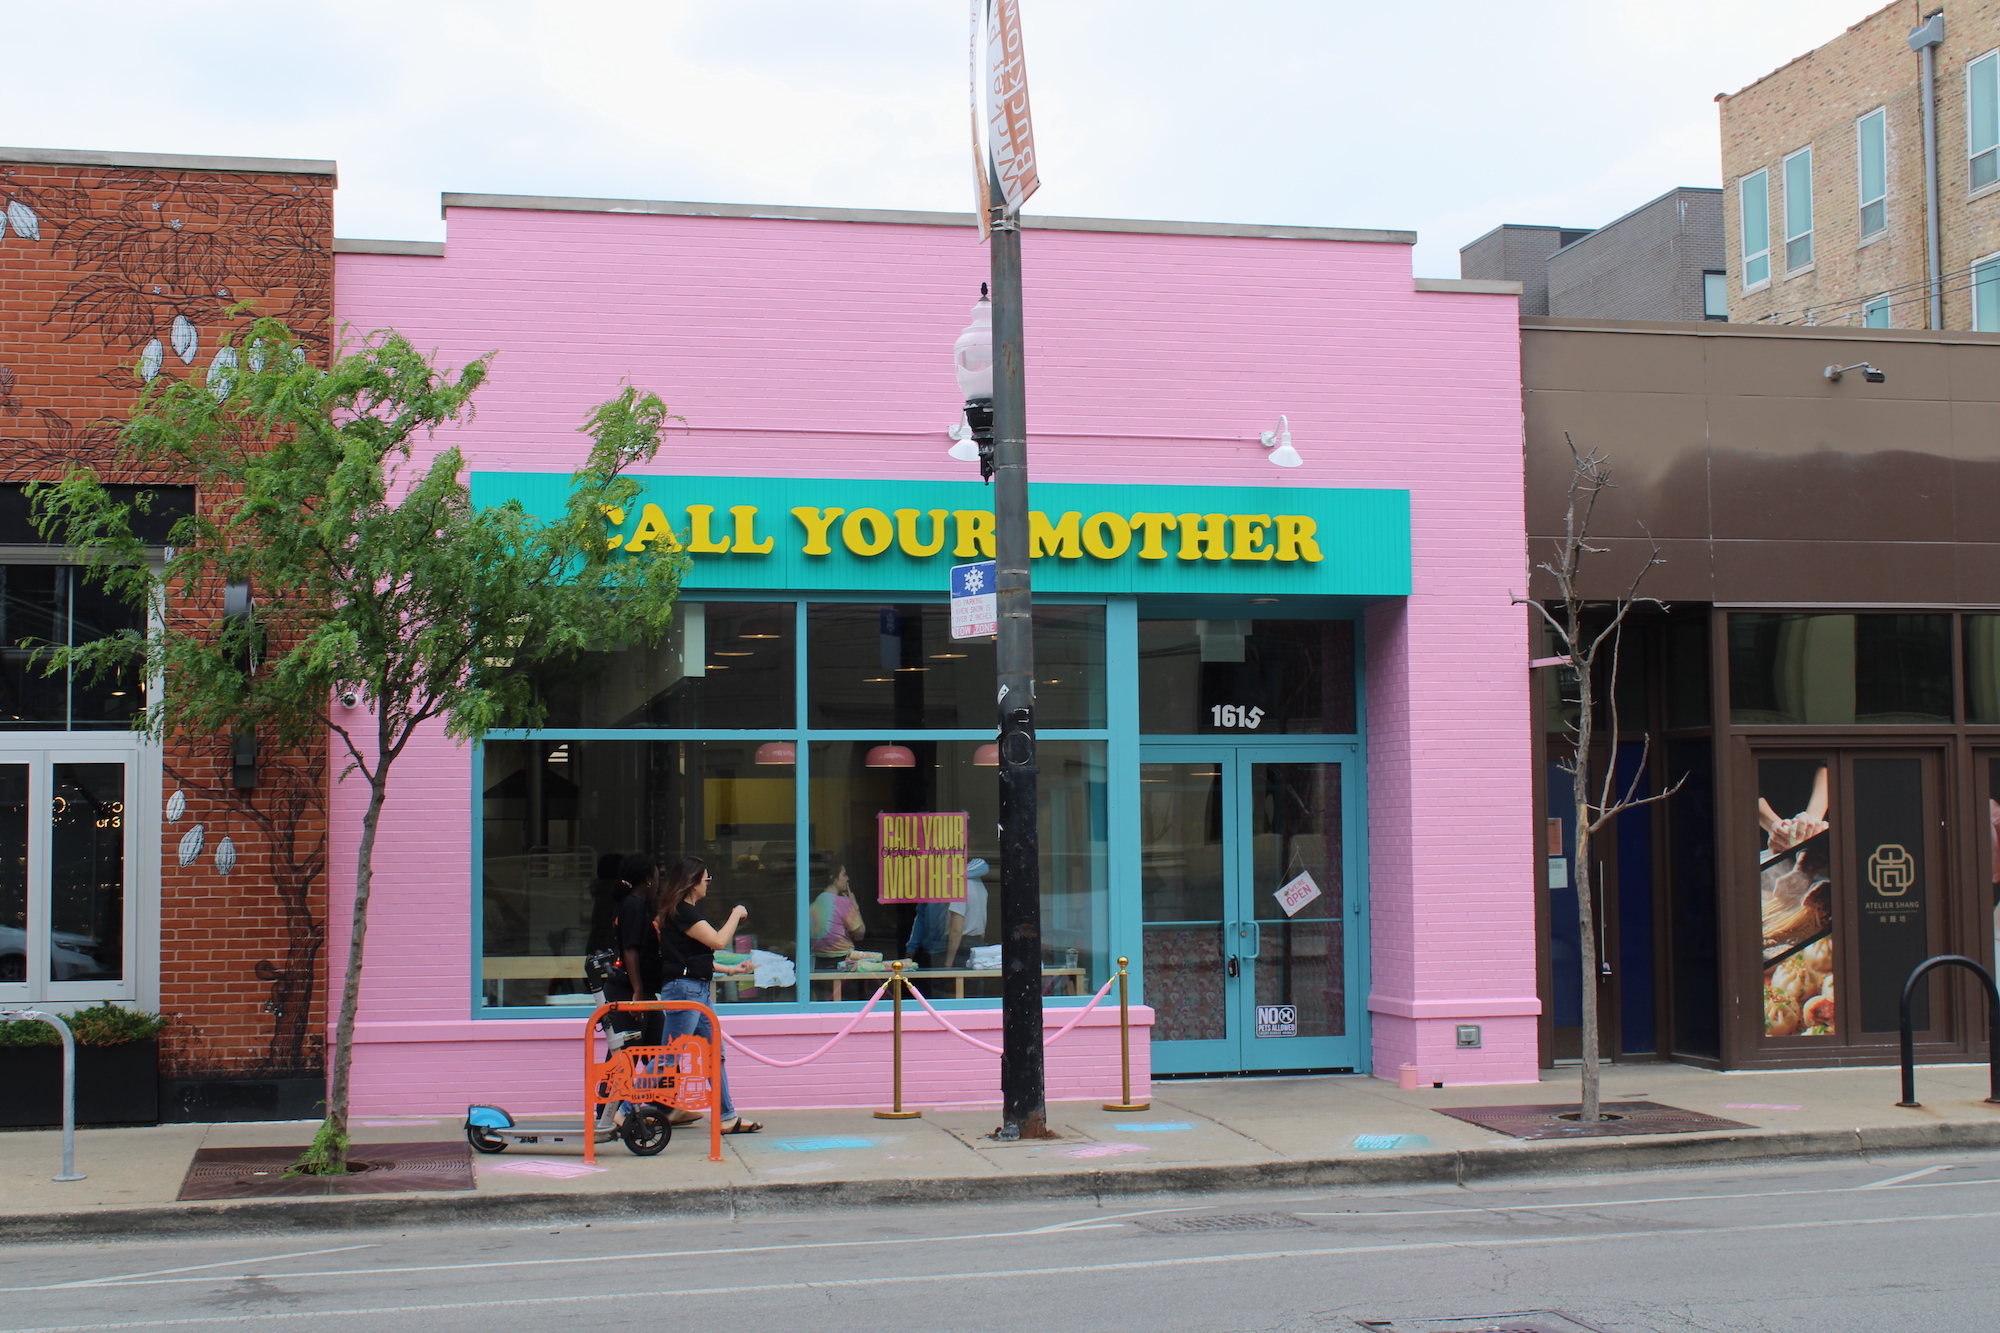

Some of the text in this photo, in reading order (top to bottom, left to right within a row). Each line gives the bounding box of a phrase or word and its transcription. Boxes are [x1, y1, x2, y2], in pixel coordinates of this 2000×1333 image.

[990, 60, 1020, 196] Wicker
[790, 506, 997, 558] YOUR
[1029, 510, 1325, 562] MOTHER
[963, 597, 983, 606] PARKING
[955, 607, 969, 615] WHEN
[970, 605, 984, 613] SNOW
[955, 615, 968, 623] OVER
[975, 612, 993, 620] INCHES
[955, 623, 995, 636] TOW ZONE
[1211, 704, 1266, 730] 1615
[883, 815, 965, 851] CALL YOUR
[881, 846, 923, 859] OPENING
[883, 854, 965, 899] MOTHER
[1286, 884, 1312, 907] OPEN
[1896, 901, 1920, 909] SHANG
[1258, 1007, 1279, 1024] NO
[632, 1076, 675, 1089] RIDES
